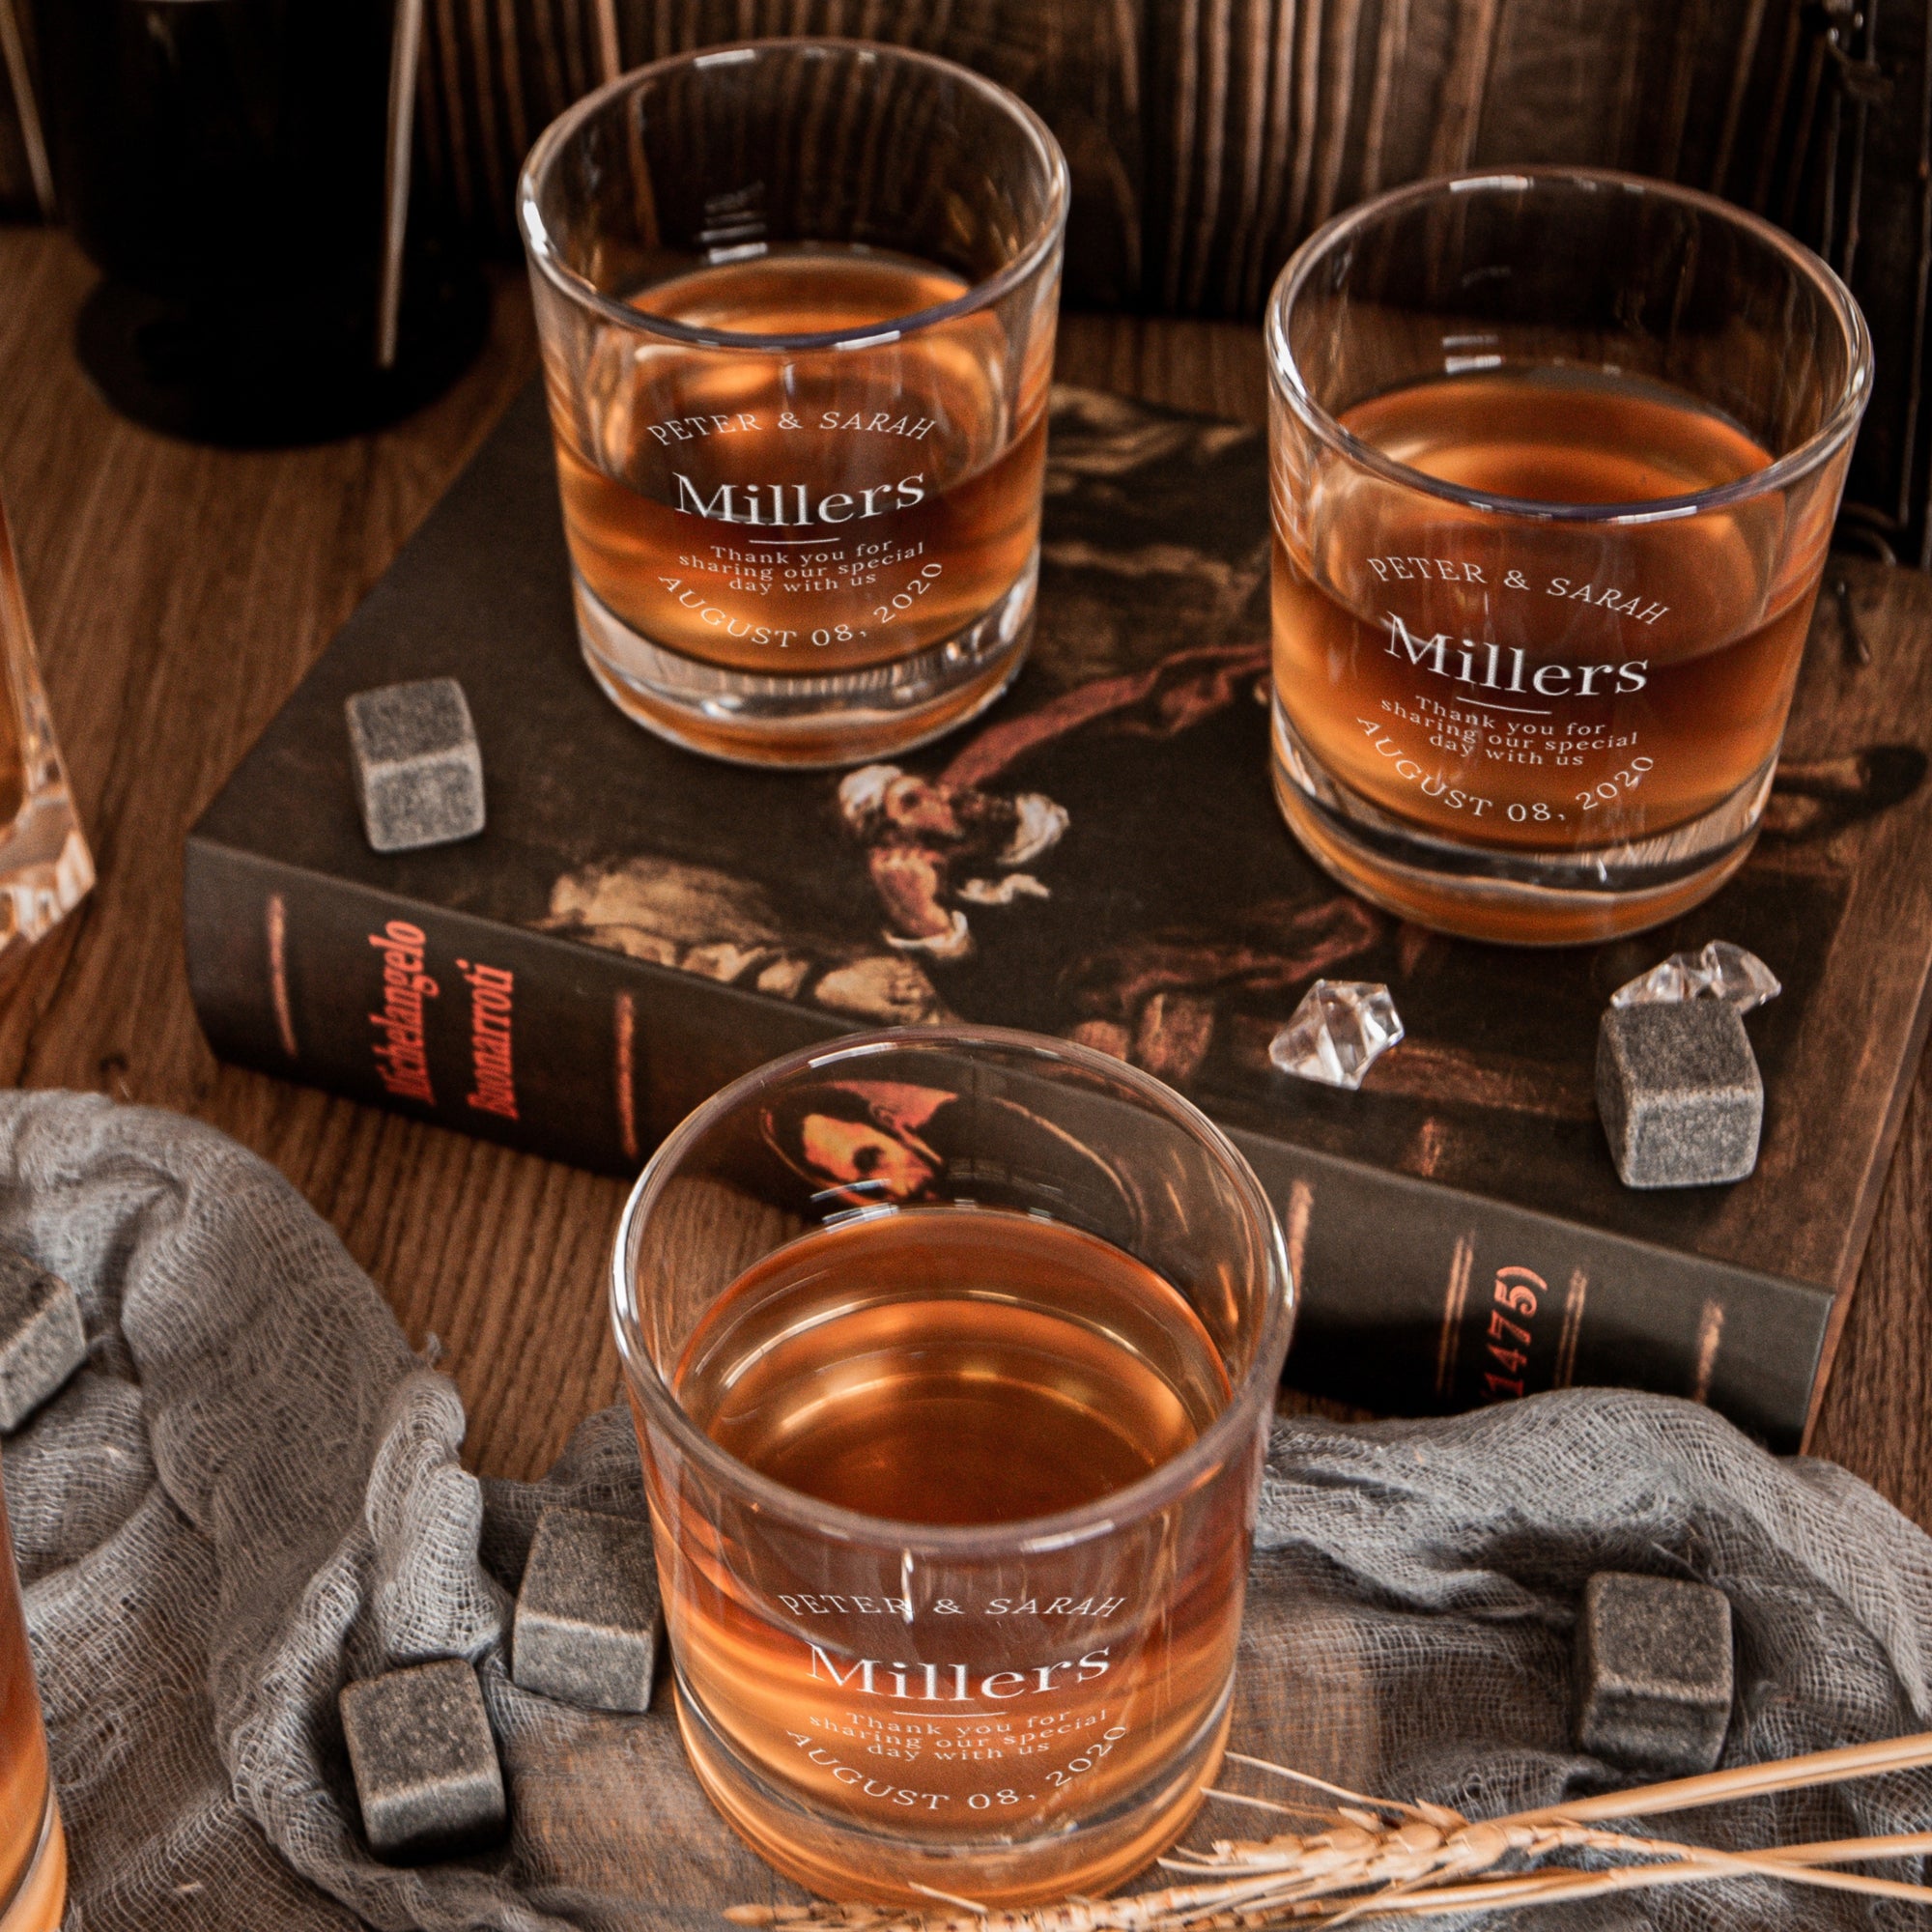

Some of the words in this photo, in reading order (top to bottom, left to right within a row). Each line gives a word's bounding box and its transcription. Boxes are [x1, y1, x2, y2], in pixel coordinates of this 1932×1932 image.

[646, 413, 762, 445] PETER
[778, 412, 803, 430] &
[820, 412, 936, 440] SARAH
[672, 471, 925, 526] Millers
[678, 554, 773, 582] sharing
[783, 566, 827, 579] our
[838, 542, 924, 576] special
[710, 545, 789, 565] Thank
[800, 550, 844, 567] you
[856, 540, 893, 558] for
[658, 576, 798, 648] AUGUST
[811, 624, 867, 646] 08,
[873, 563, 943, 623] 2020
[729, 578, 773, 595] day
[783, 578, 838, 592] with
[851, 573, 876, 587] us
[1367, 556, 1488, 583] PETER
[1503, 570, 1531, 591] &
[1546, 578, 1669, 625] SARAH
[1384, 611, 1649, 696] Millers
[1380, 698, 1477, 744] sharing
[1488, 734, 1534, 749] our
[1545, 732, 1637, 753] special
[1415, 696, 1496, 729] Thank
[1507, 723, 1554, 736] you
[1566, 722, 1605, 736] for
[1356, 717, 1493, 817] AUGUST
[1507, 803, 1566, 822] 08,
[1576, 756, 1654, 811] 2020
[1429, 733, 1474, 757] day
[1485, 748, 1544, 766] with
[1556, 753, 1584, 766] us
[368, 920, 440, 1106] Michelangelo
[455, 957, 520, 1121] Buonarroti
[778, 1594, 913, 1615] PETER
[933, 1598, 966, 1615] &
[985, 1597, 1125, 1618] SARAH
[805, 1640, 1111, 1701] Millers
[809, 1716, 923, 1749] sharing
[936, 1738, 988, 1748] our
[1004, 1709, 1107, 1746] special
[846, 1712, 943, 1735] Thank
[956, 1723, 1011, 1738] you
[1027, 1710, 1070, 1728] for
[785, 1729, 951, 1810] AUGUST
[968, 1788, 1036, 1809] 08,
[1045, 1725, 1129, 1787] 2020
[867, 1744, 921, 1762] day
[934, 1746, 1003, 1761] with
[1019, 1741, 1050, 1755] us
